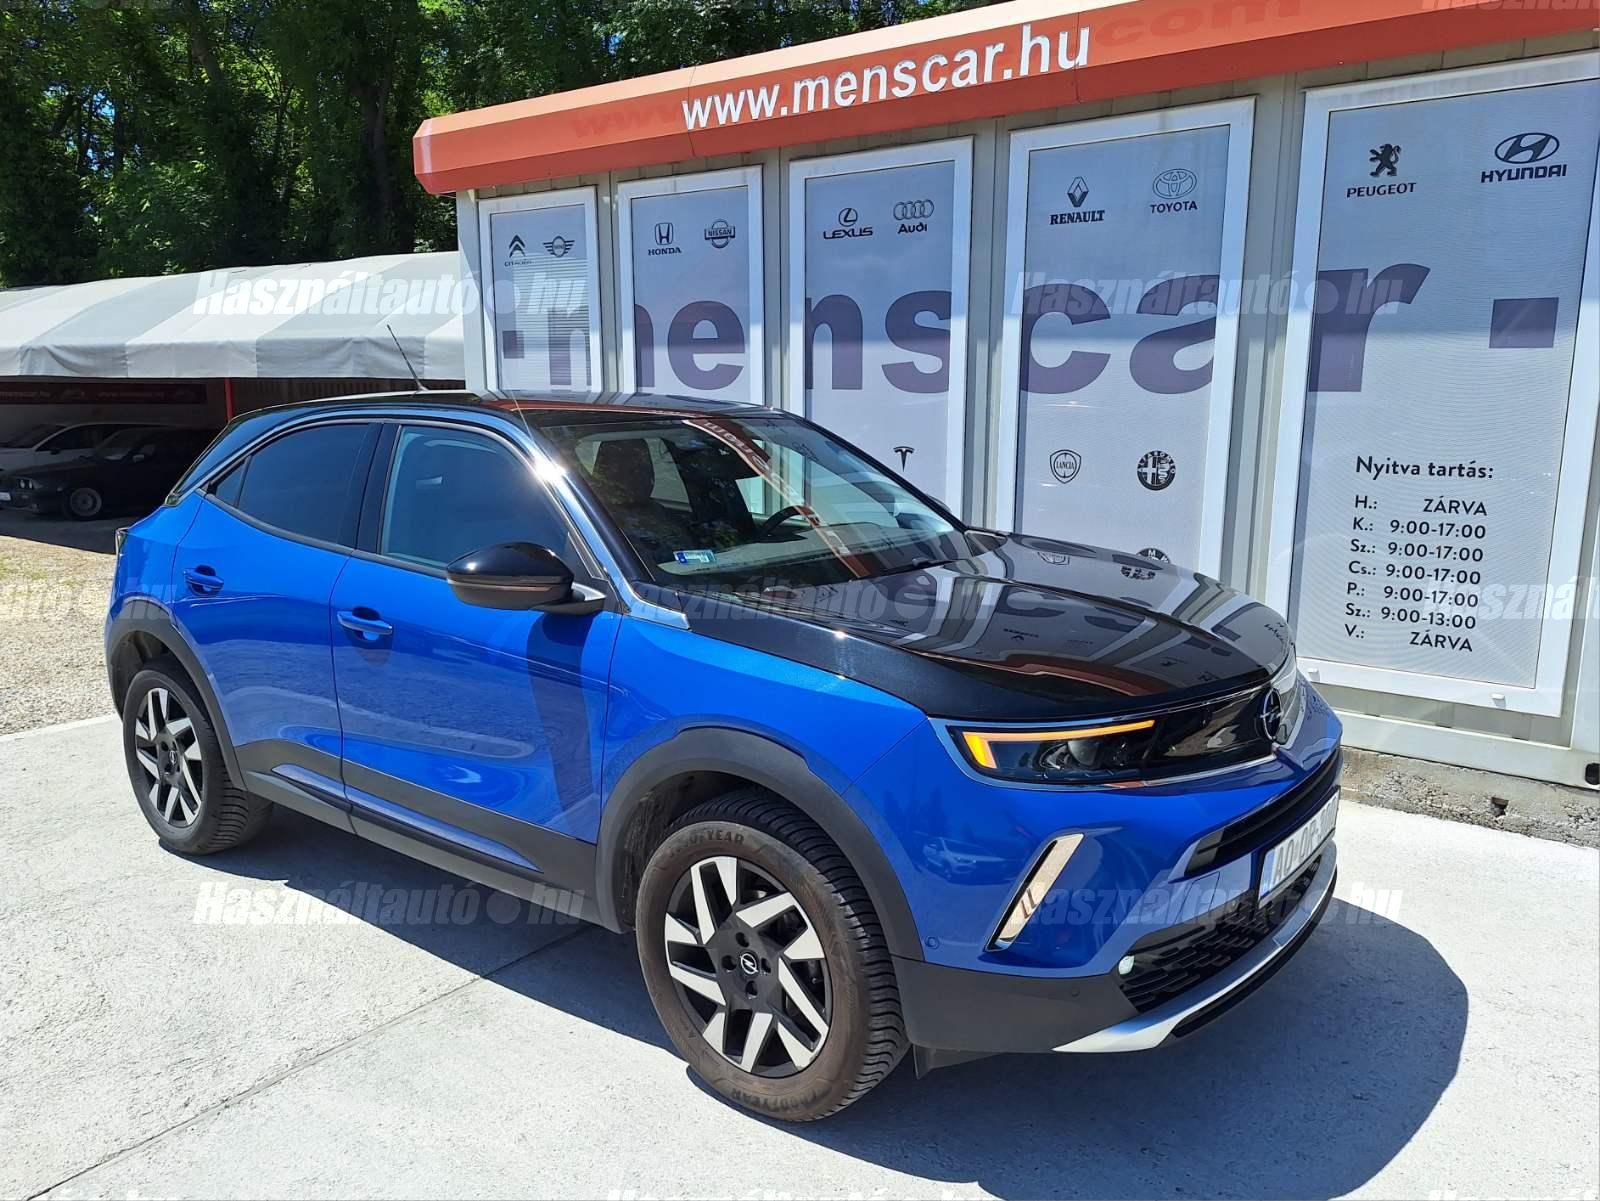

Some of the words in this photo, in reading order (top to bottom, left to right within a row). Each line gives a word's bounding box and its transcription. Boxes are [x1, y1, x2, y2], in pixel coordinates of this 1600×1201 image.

[681, 24, 1090, 131] www.menscar.hu
[1481, 164, 1567, 184] HYUNDAI
[1346, 182, 1417, 198] PEUGEOT
[1050, 210, 1105, 225] RENAULT
[1150, 201, 1198, 214] TOYOTA
[707, 228, 732, 237] NISSAN
[823, 227, 873, 239] LEXUS
[897, 222, 928, 234] Audi
[648, 246, 682, 256] HONDA
[1356, 455, 1420, 480] Nyitva
[1428, 460, 1493, 479] tartás:
[1354, 495, 1378, 510] H.:
[1423, 495, 1487, 516] ZÁRVA
[1352, 516, 1374, 531] K.:
[1390, 519, 1486, 539] 9:00-17:00
[1350, 538, 1376, 553] Sz.:
[1388, 541, 1483, 562] 9:00-17:00
[1348, 560, 1377, 575] Cs.:
[1385, 563, 1481, 585] 9:00-17:00
[1347, 582, 1365, 596] P.:
[1383, 585, 1479, 607] 9:00-17:00
[1345, 602, 1371, 618] Sz.:
[1381, 606, 1476, 629] 9:00-13:00
[1344, 624, 1365, 639] V.:
[1409, 630, 1473, 652] ZÁRVA
